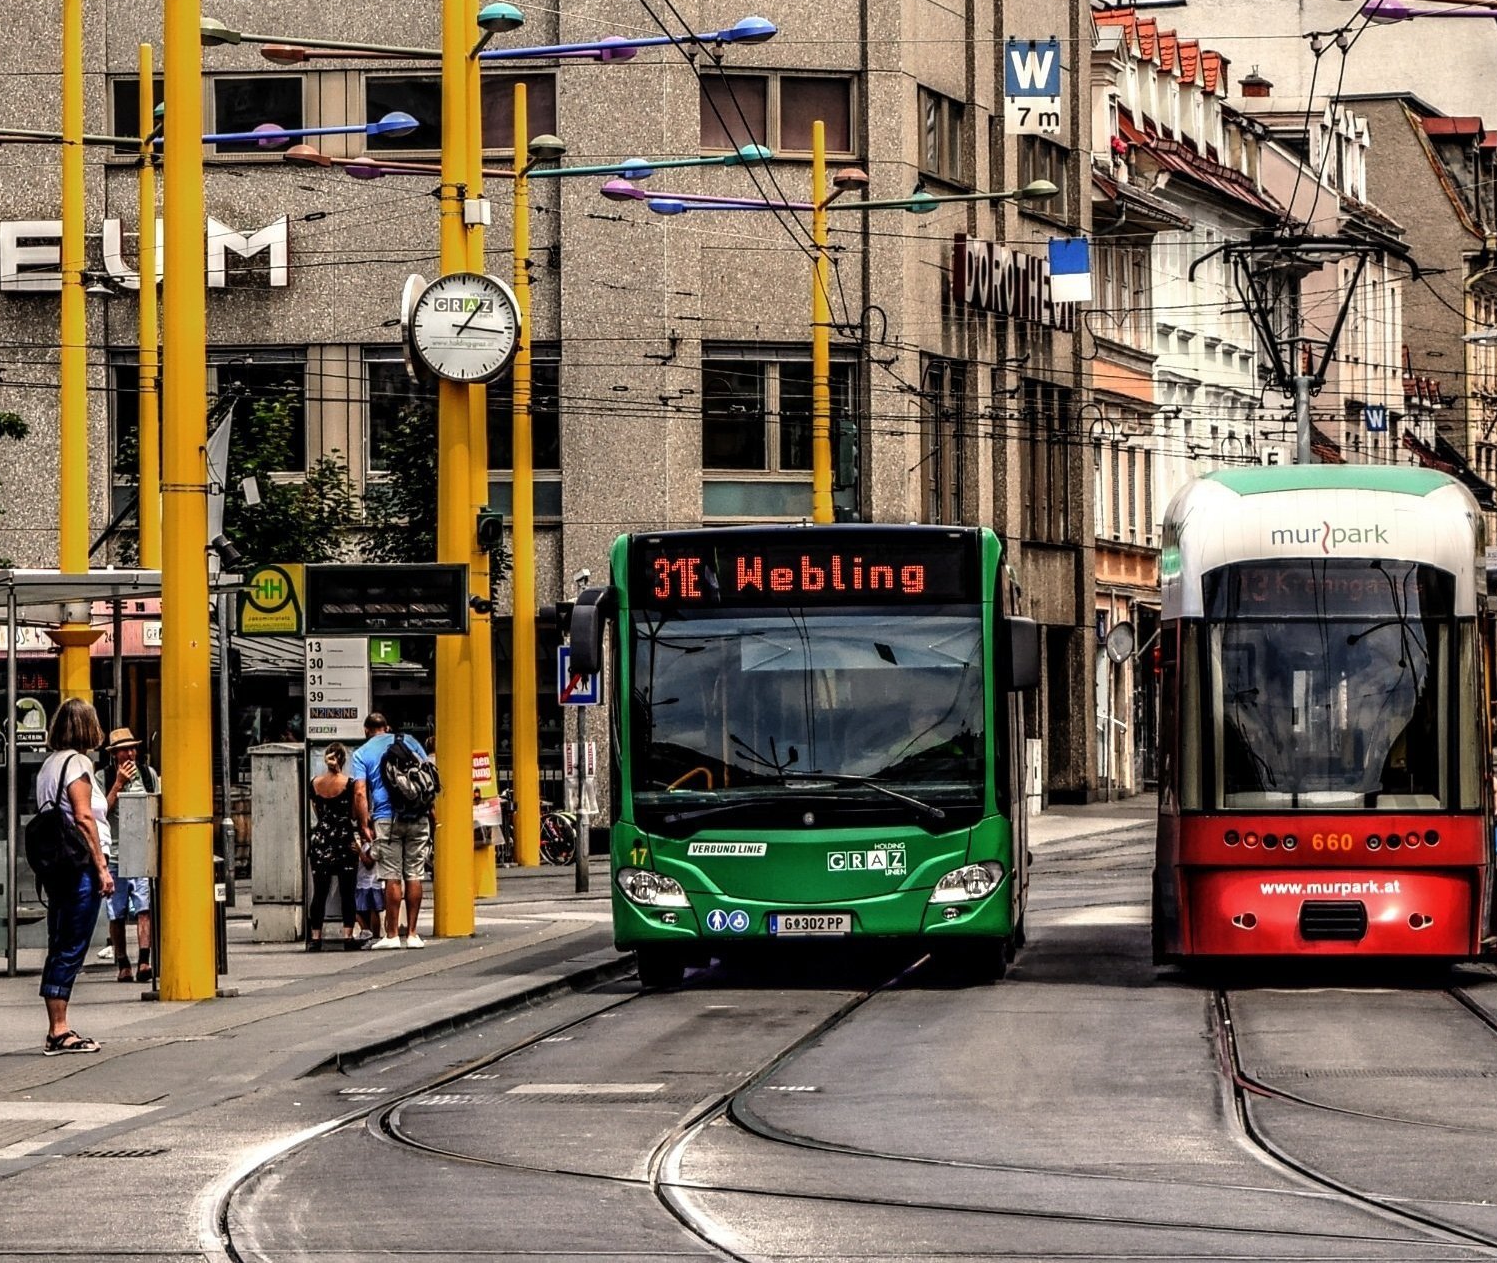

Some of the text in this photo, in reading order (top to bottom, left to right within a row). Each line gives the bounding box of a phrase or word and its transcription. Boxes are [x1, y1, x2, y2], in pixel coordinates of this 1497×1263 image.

[1010, 50, 1055, 90] W
[1017, 107, 1060, 127] 7 m
[434, 298, 493, 312] GRAZ
[1366, 409, 1384, 428] W
[654, 554, 925, 598] 31E Webling
[255, 578, 283, 600] HH
[307, 641, 322, 653] 13
[380, 641, 393, 658] F
[309, 658, 324, 669] 30
[309, 674, 323, 685] 31
[309, 691, 324, 703] 39
[691, 843, 764, 855] VERBUND LINIE
[874, 842, 906, 850] HOLDING
[1312, 833, 1353, 851] 660
[630, 848, 647, 866] 17
[829, 851, 905, 870] GRAZ
[1260, 879, 1401, 897] www.murpark.at
